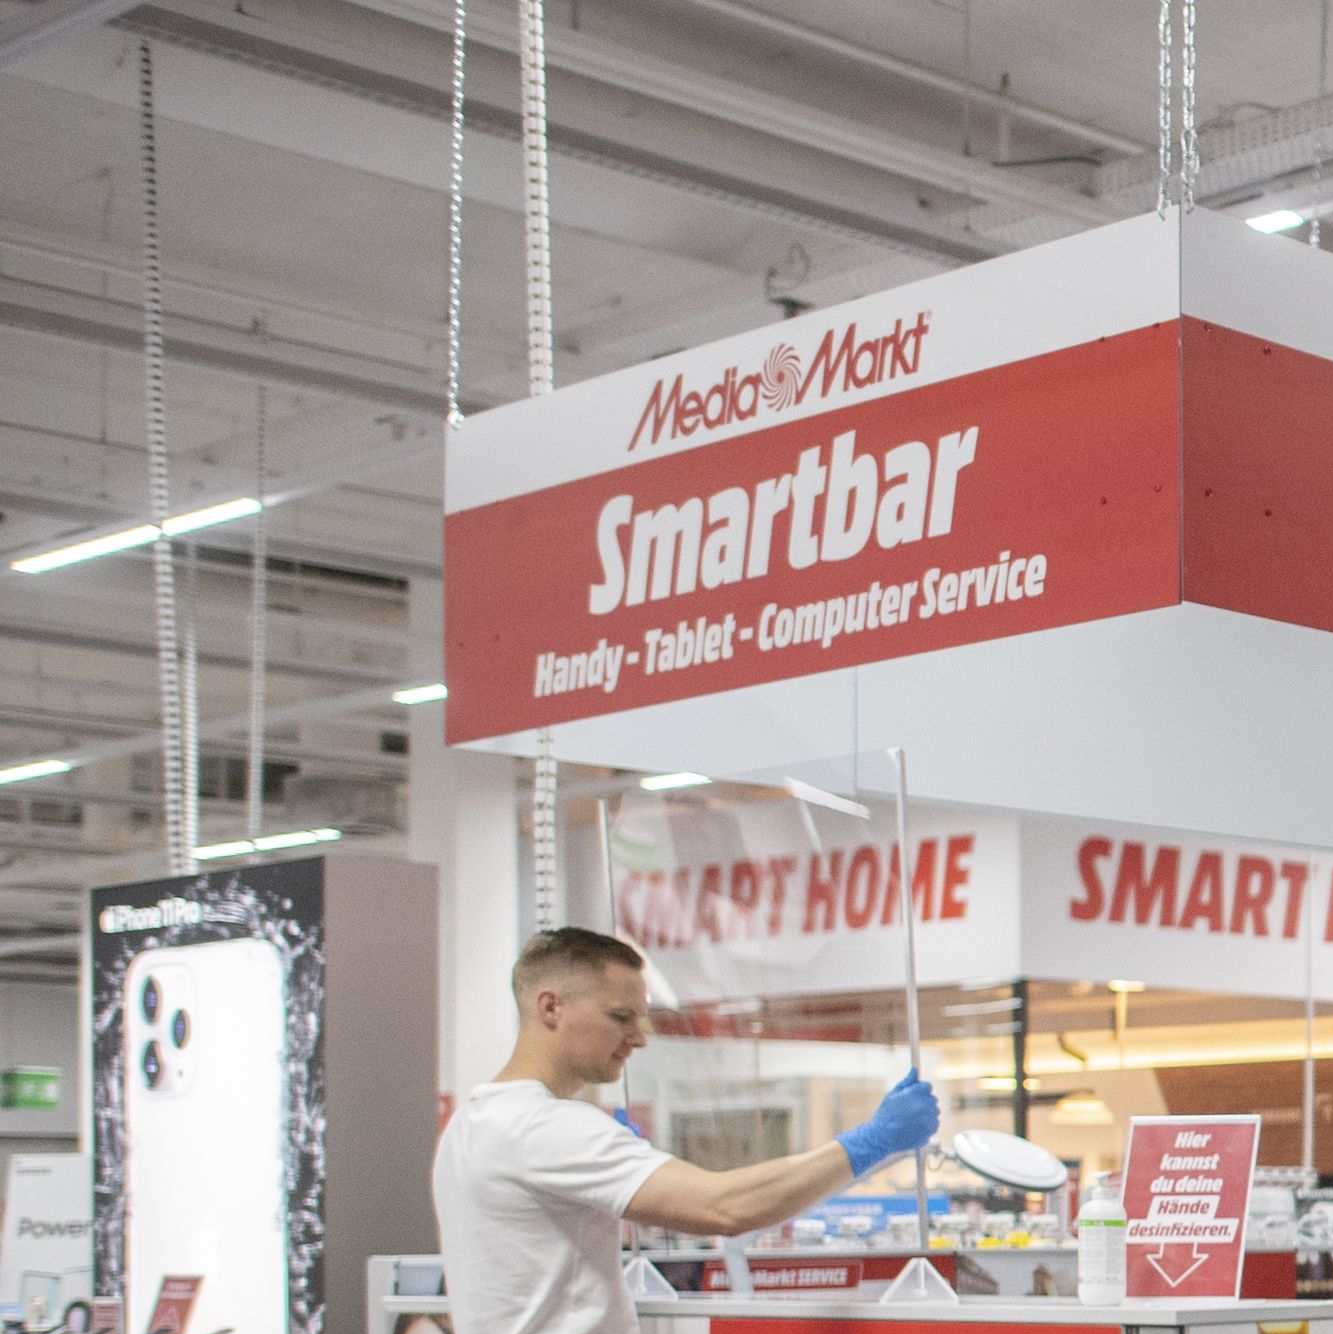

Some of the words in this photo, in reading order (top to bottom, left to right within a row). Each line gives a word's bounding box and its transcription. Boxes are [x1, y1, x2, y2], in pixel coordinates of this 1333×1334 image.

[589, 427, 979, 615] Smartbar
[535, 637, 623, 699] Handy
[645, 613, 734, 676] Tablet
[758, 578, 918, 653] Computer
[920, 552, 1047, 620] Service
[802, 834, 977, 935] HOME
[1069, 836, 1311, 940] SMART
[1174, 1130, 1212, 1149] Hier
[1159, 1152, 1220, 1171] kannst
[1150, 1175, 1174, 1194] du
[1174, 1174, 1224, 1194] deine
[1156, 1198, 1211, 1215] Hände
[1128, 1221, 1232, 1238] desinfizieren.
